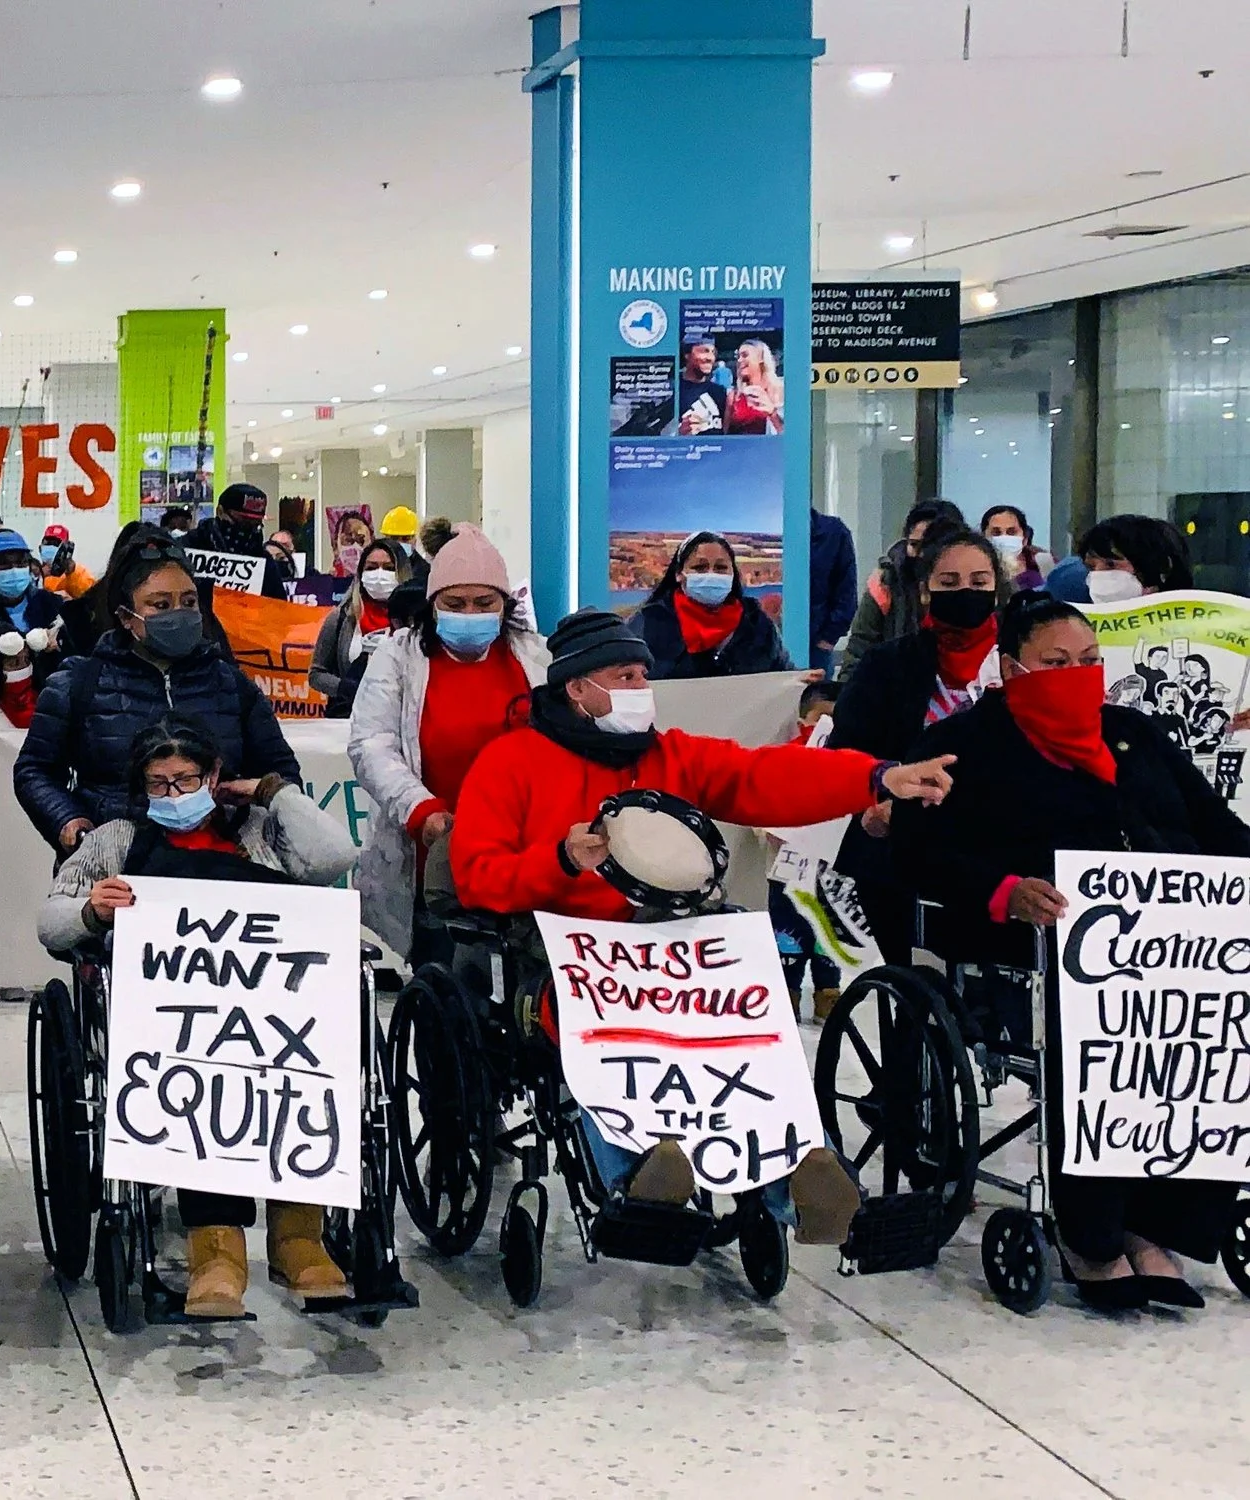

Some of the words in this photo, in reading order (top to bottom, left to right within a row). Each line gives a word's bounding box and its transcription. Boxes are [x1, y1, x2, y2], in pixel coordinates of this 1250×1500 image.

[610, 267, 693, 292] MAKING
[700, 266, 718, 291] IT
[725, 266, 786, 291] DAIRY
[812, 290, 850, 299] USEUM,
[902, 288, 951, 298] ARCHIVES
[812, 302, 846, 310] GENCY
[851, 301, 883, 310] BLDGS
[812, 314, 854, 322] ORNING
[858, 313, 892, 322] TOWER
[812, 326, 872, 335] BSERVATION
[877, 326, 903, 335] DECK
[827, 338, 841, 348] TO
[844, 338, 893, 348] MADISON
[898, 337, 938, 346] AVENUE
[1143, 607, 1186, 625] THE
[1078, 863, 1250, 907] GOVERNO
[176, 907, 283, 943] WE
[142, 942, 330, 992] WANT
[566, 932, 742, 980] RAISE
[559, 964, 771, 1021] Revenue
[156, 1005, 320, 1068] TAX
[1098, 988, 1250, 1049] UNDER
[600, 1056, 775, 1108] TAX
[1079, 1039, 1250, 1105] FUNDED
[655, 1109, 732, 1132] THE
